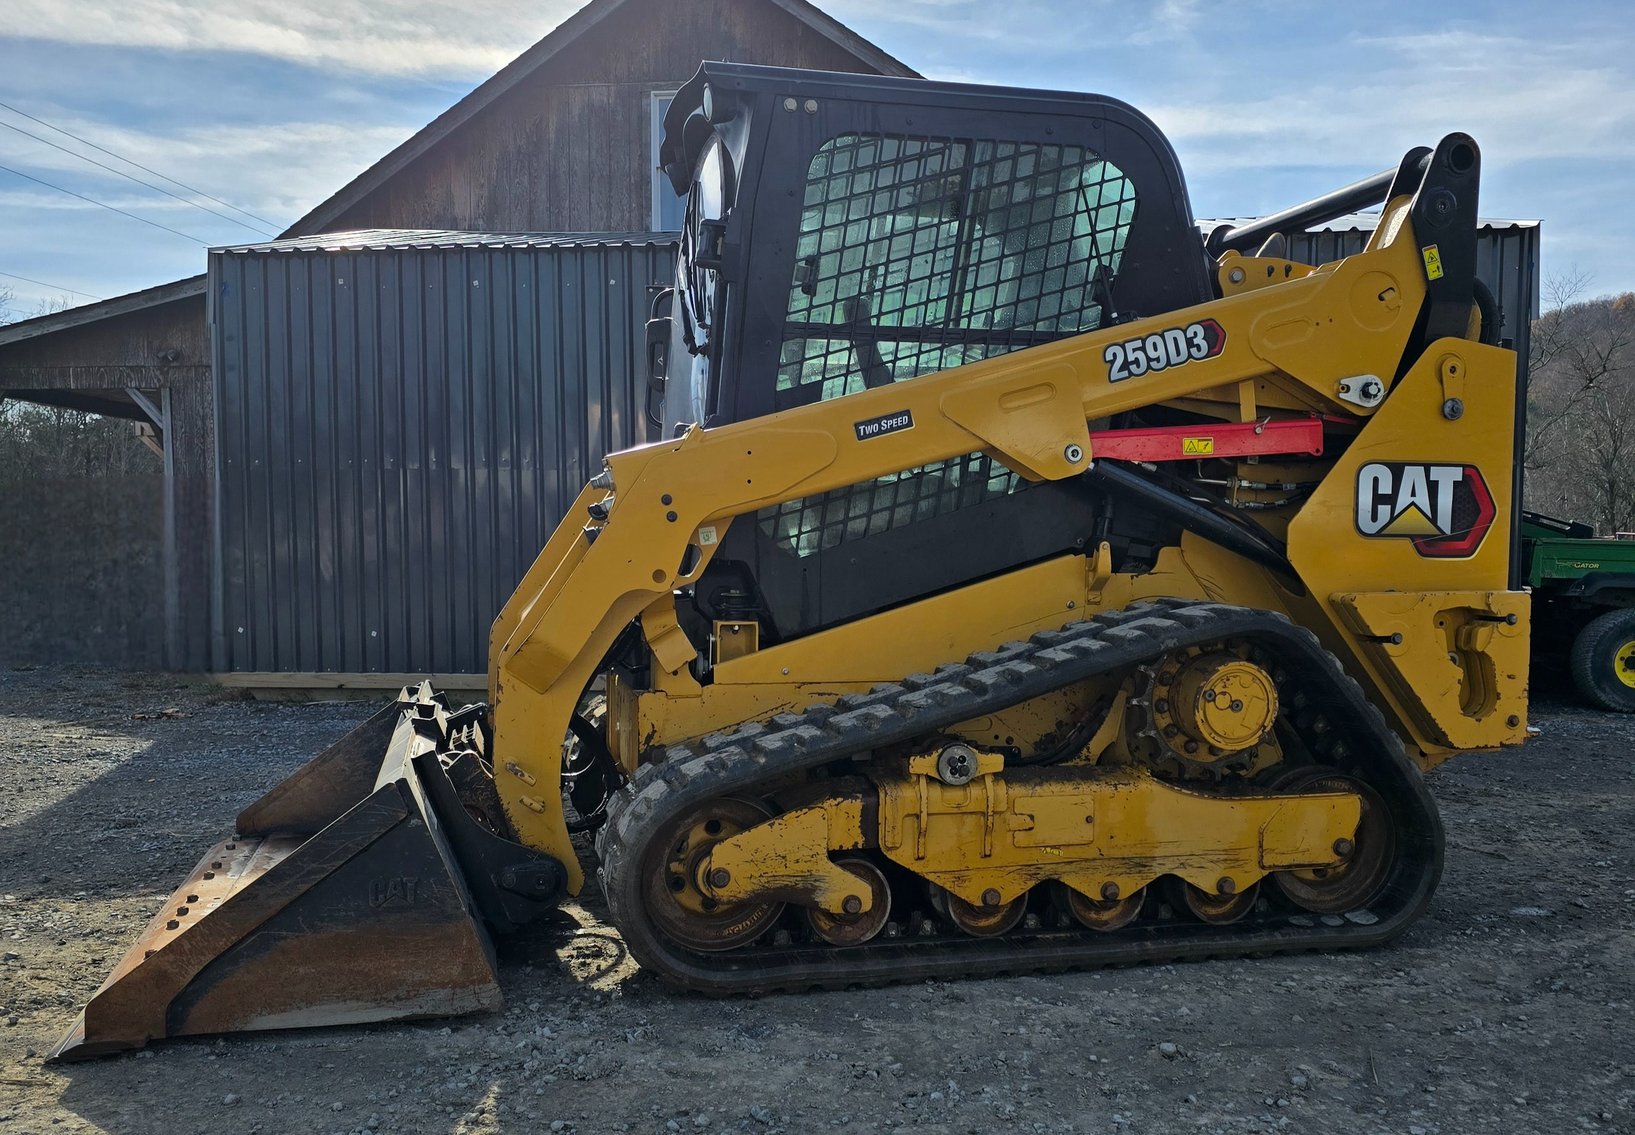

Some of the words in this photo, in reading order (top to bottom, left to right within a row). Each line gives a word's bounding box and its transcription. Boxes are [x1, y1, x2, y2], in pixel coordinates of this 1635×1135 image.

[1105, 324, 1208, 381] 259D3
[858, 423, 879, 436] TWO
[881, 415, 909, 431] SPEED
[1357, 463, 1463, 535] CAT
[368, 877, 418, 907] CAT
